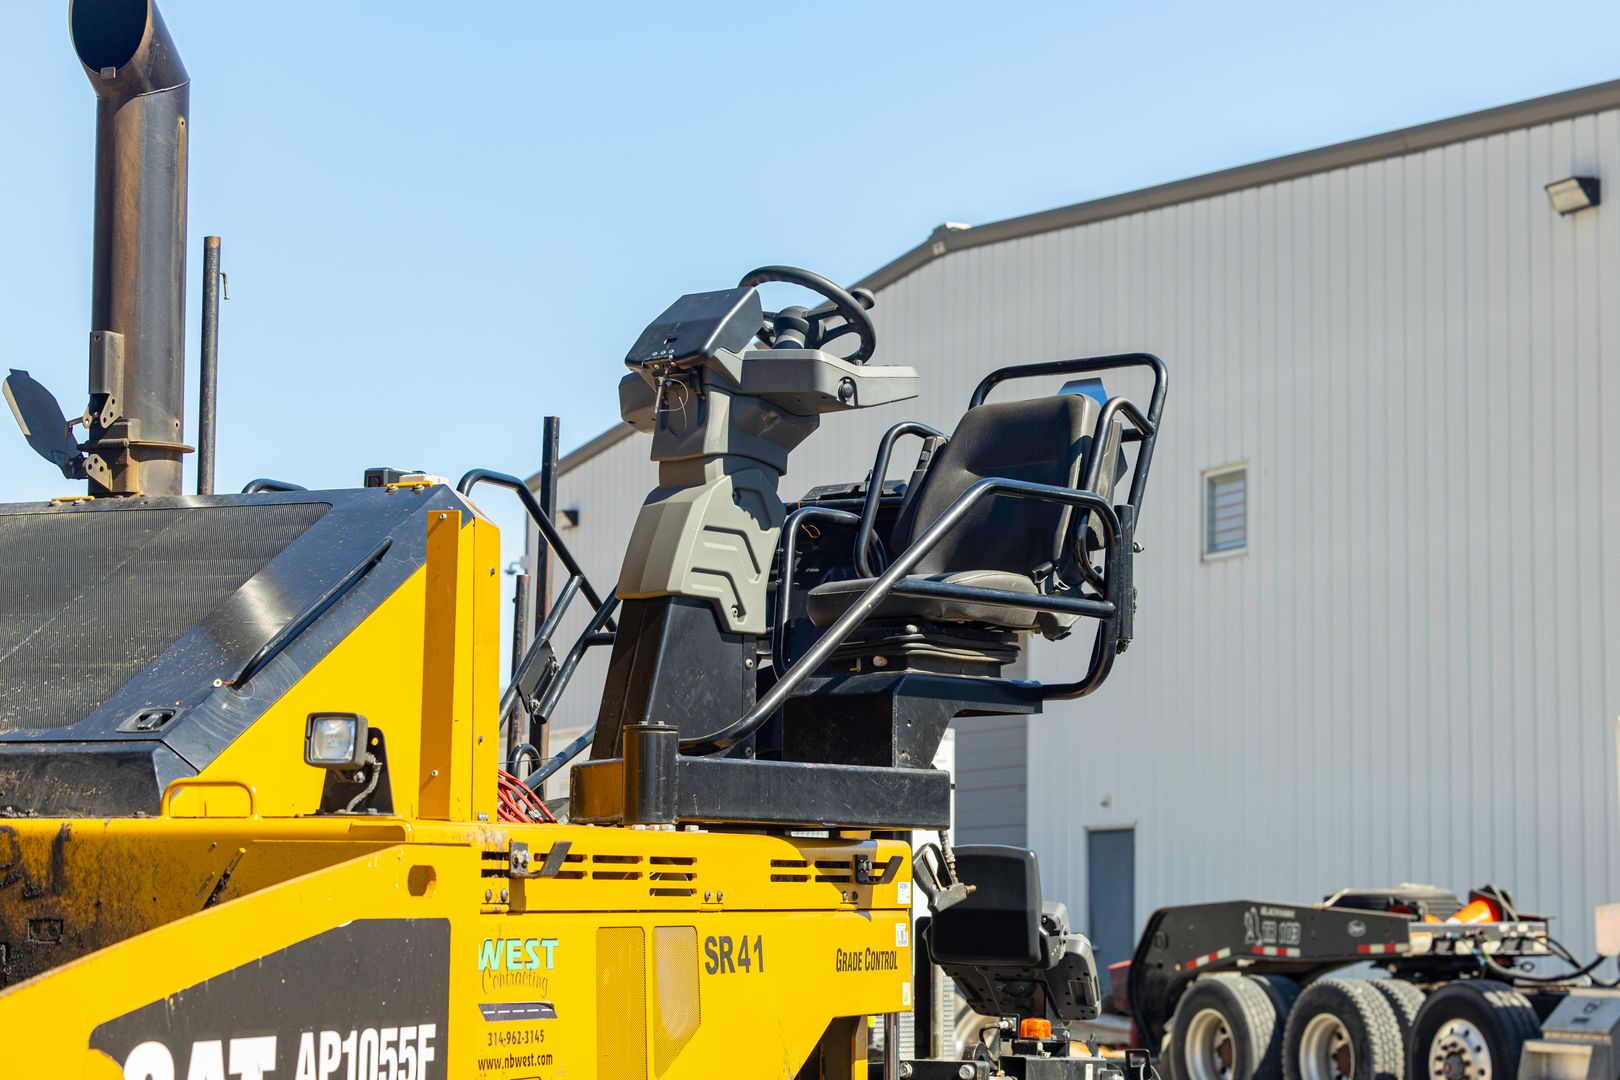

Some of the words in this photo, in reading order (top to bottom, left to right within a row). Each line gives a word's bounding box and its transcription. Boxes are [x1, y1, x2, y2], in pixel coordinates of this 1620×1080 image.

[478, 938, 559, 971] WEST
[704, 935, 764, 975] SR41
[836, 948, 862, 972] GRADE
[864, 947, 898, 971] CONTROL
[481, 967, 548, 998] Contracting
[295, 1023, 436, 1080] AP1055F
[488, 1029, 545, 1046] 314-962-3145
[478, 1053, 553, 1070] www.nbwest.com
